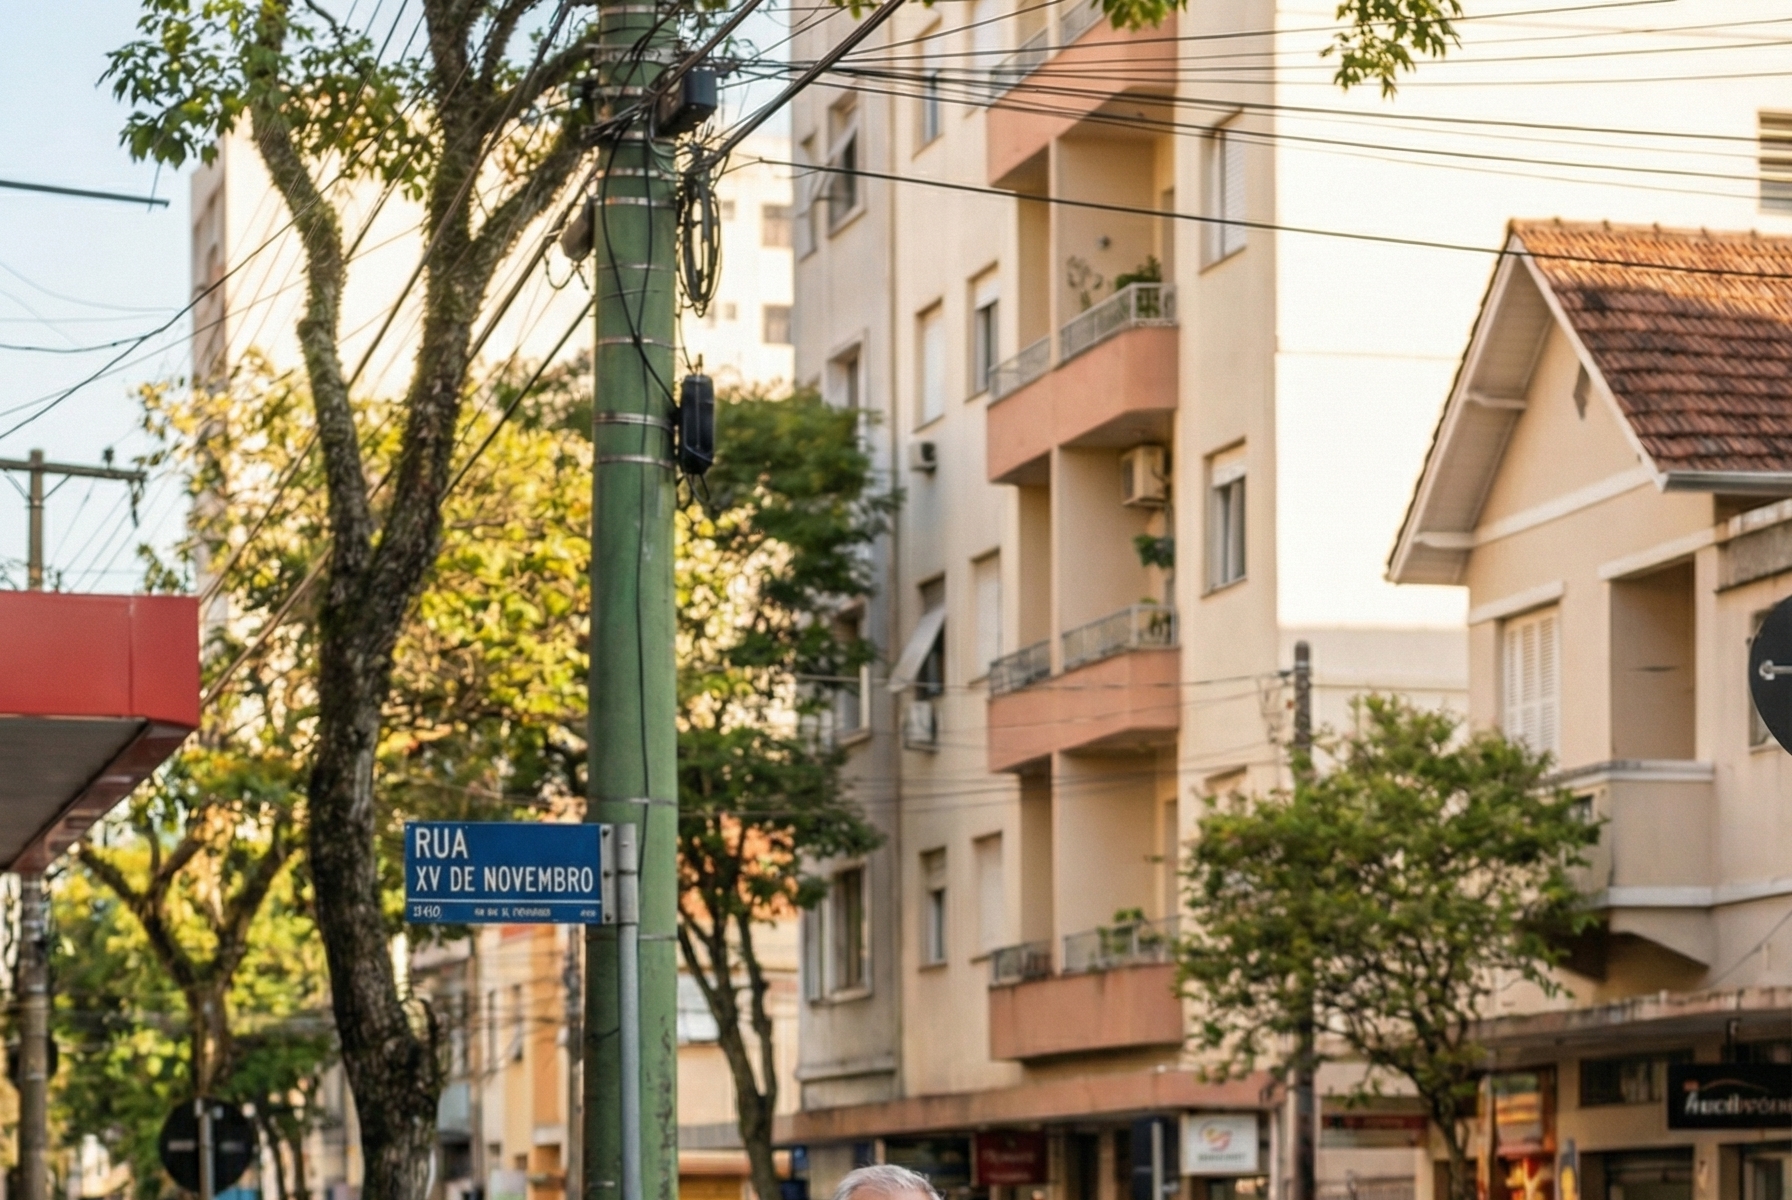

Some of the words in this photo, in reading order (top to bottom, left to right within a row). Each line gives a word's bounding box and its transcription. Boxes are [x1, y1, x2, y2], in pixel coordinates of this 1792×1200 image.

[415, 828, 469, 859] RUA
[416, 866, 441, 892] XV
[451, 866, 475, 892] DE
[484, 866, 594, 893] NOVEMBRO
